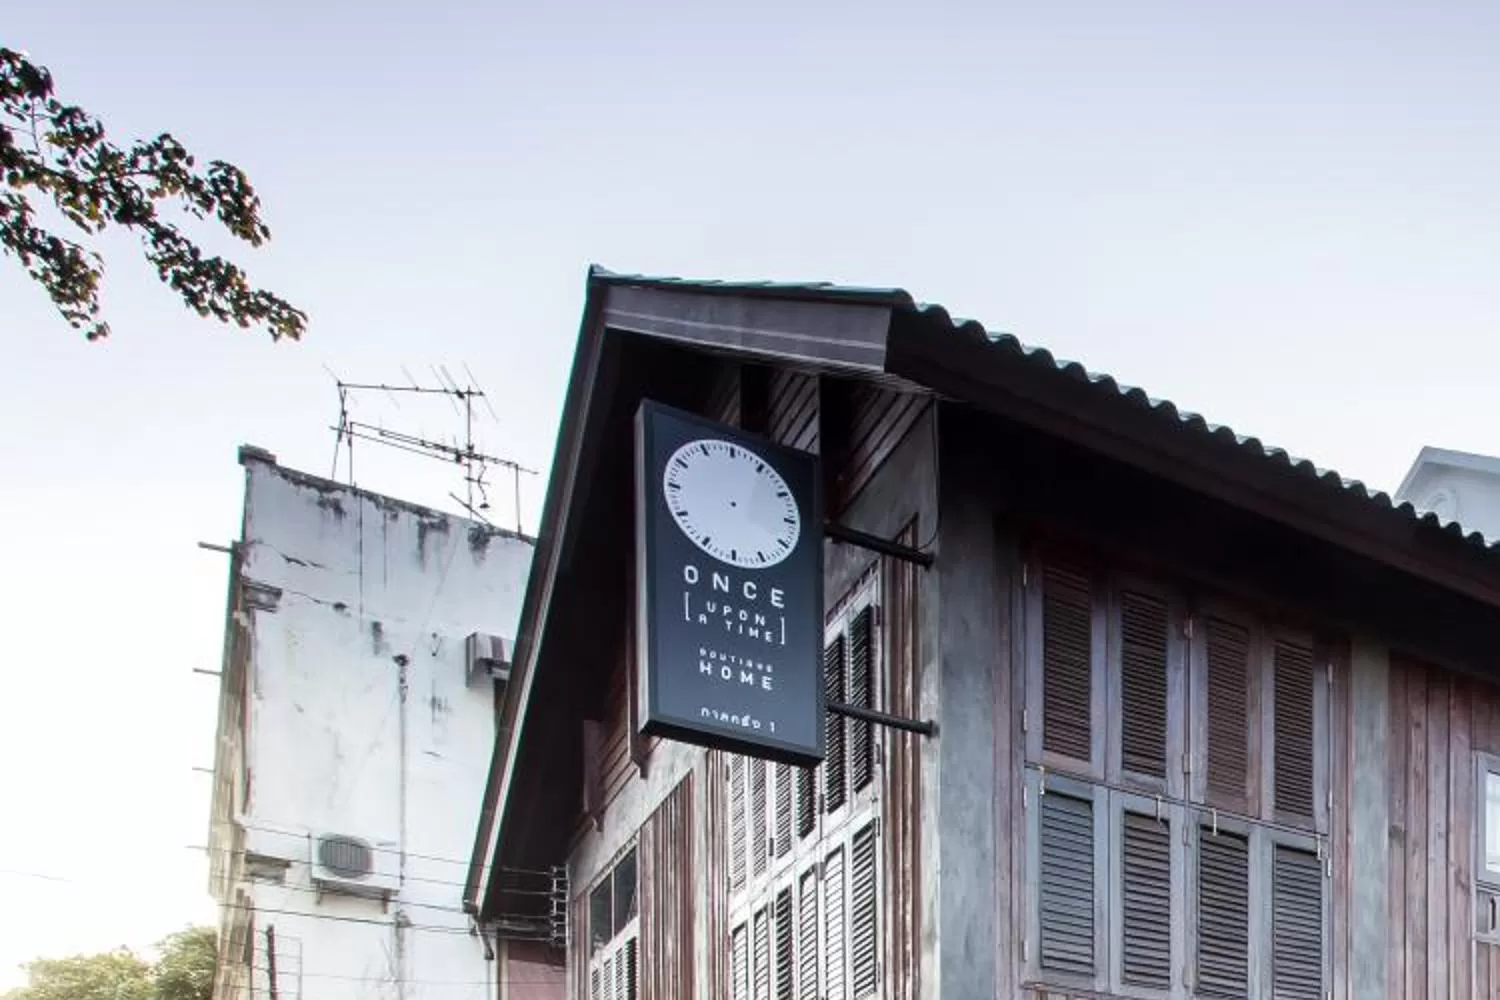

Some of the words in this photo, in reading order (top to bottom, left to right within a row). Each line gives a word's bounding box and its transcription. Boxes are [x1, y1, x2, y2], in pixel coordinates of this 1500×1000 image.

[684, 565, 784, 608] ONCE
[698, 614, 707, 625] A
[726, 620, 773, 643] TIME
[707, 601, 765, 626] UPON
[699, 660, 773, 691] HOME
